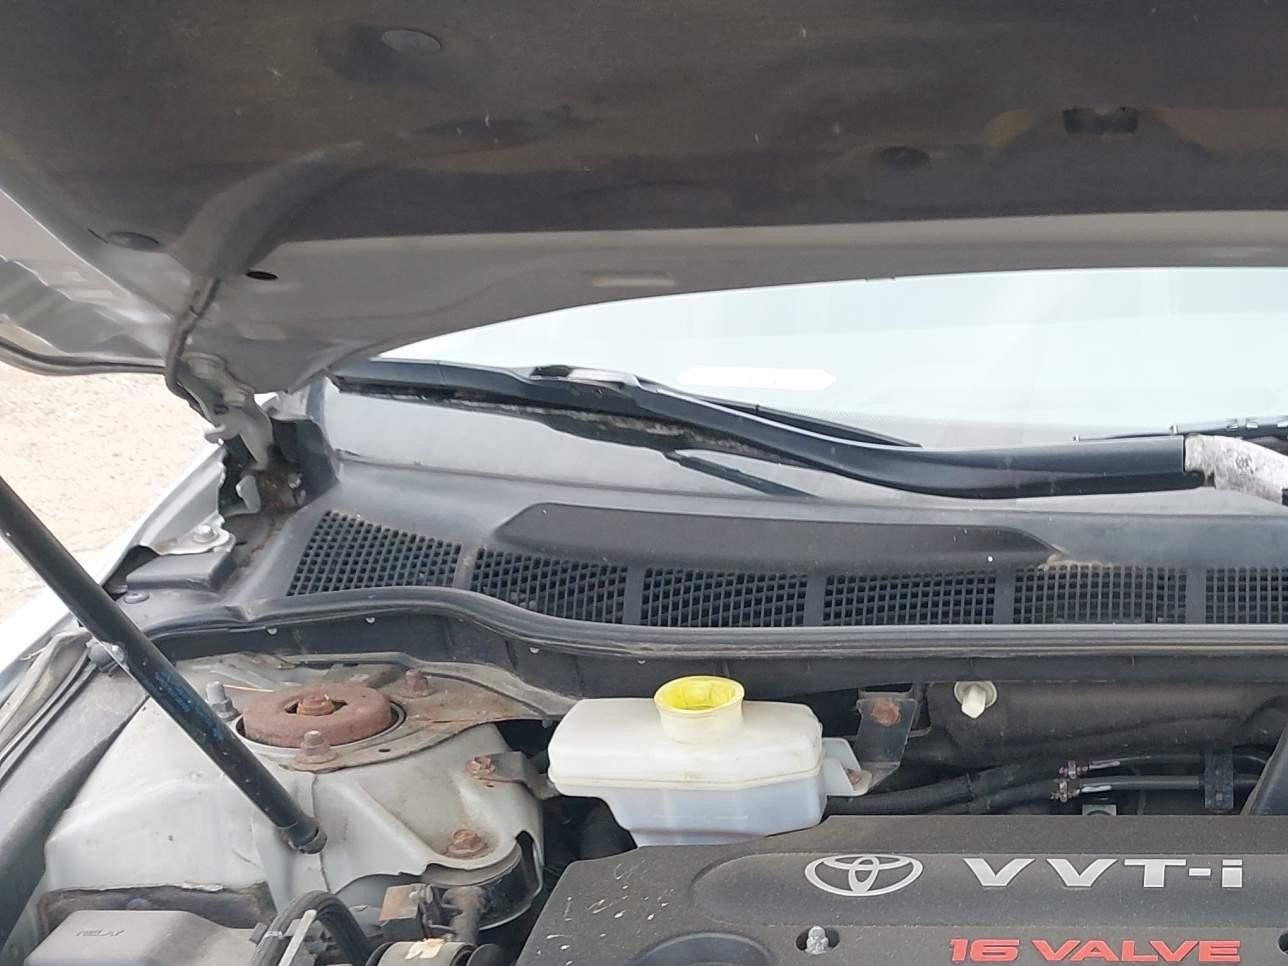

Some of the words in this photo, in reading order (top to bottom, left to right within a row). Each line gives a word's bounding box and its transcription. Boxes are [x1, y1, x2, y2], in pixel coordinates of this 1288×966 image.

[961, 857, 1244, 888] VVT-i
[950, 938, 1020, 962] 16
[1032, 939, 1242, 963] VALVE
